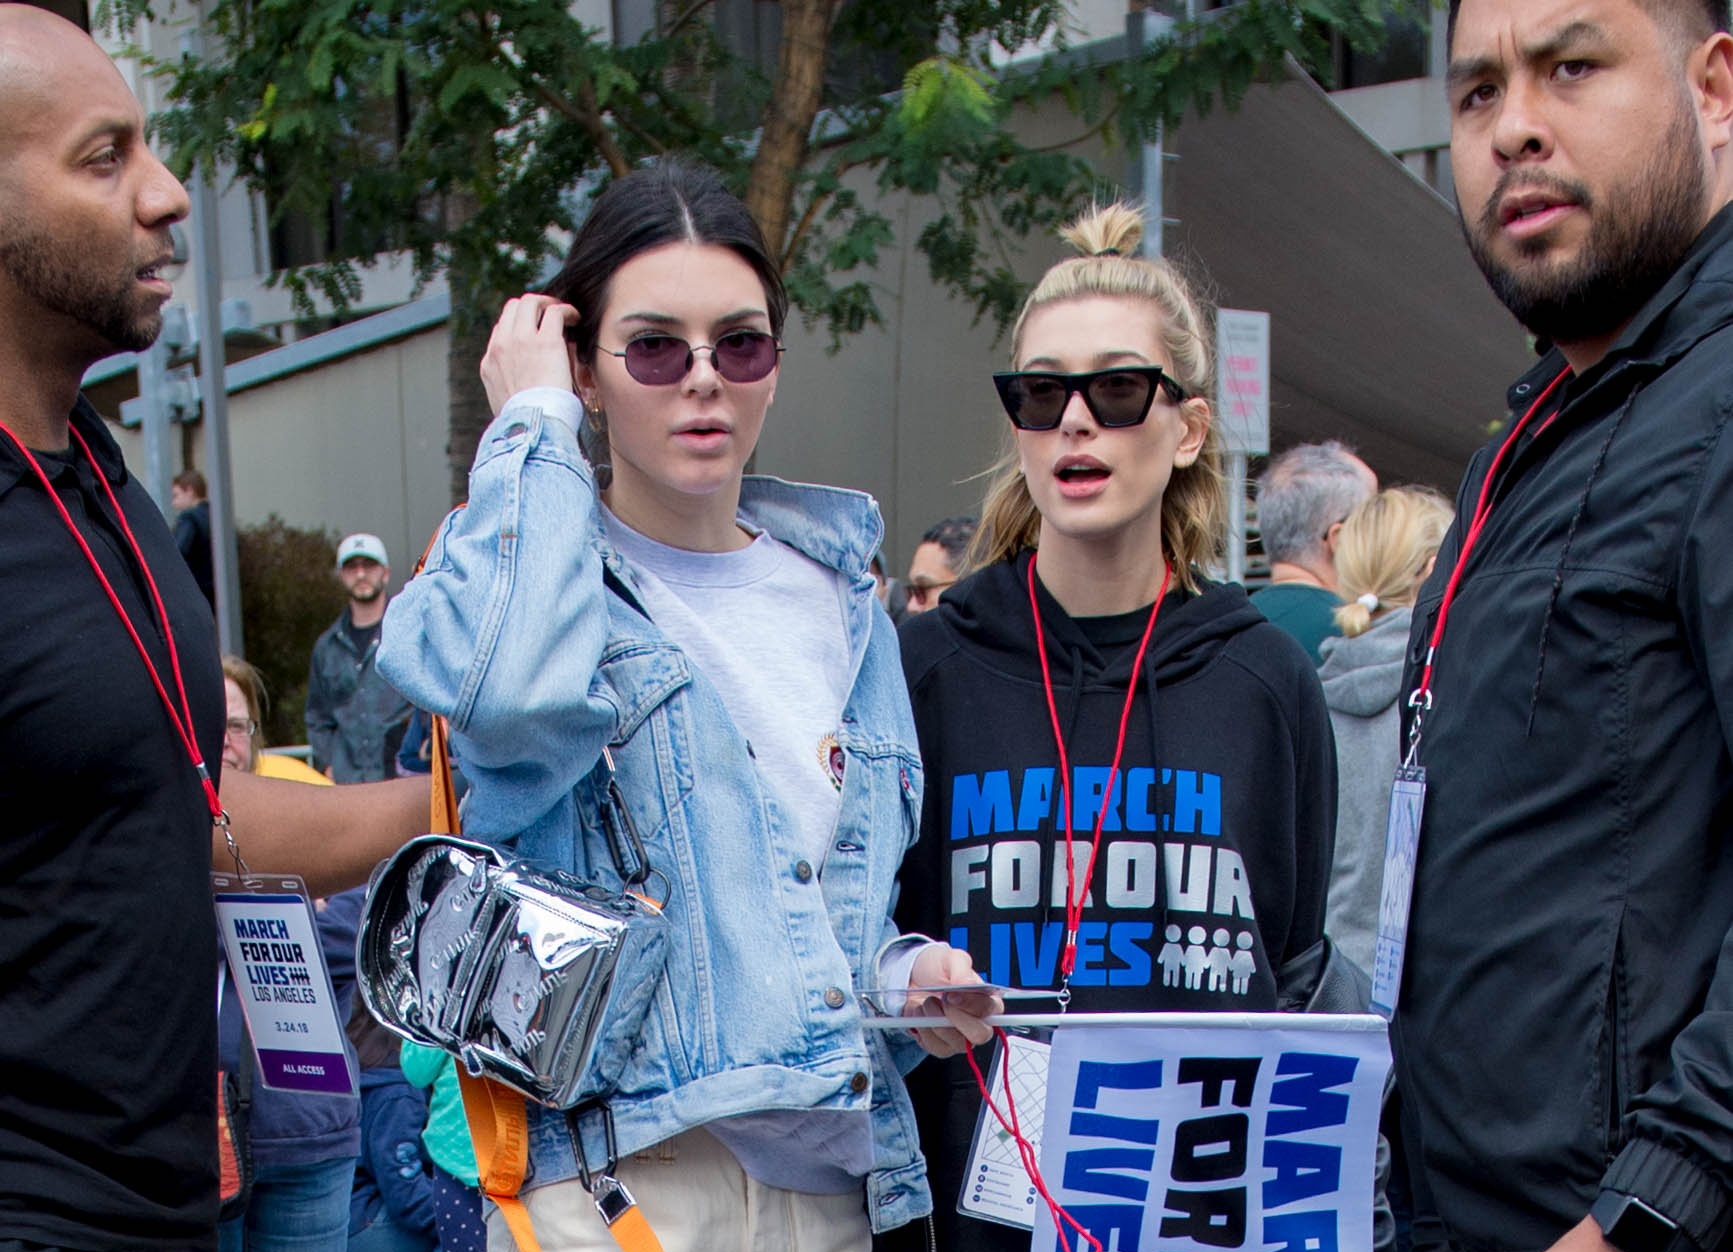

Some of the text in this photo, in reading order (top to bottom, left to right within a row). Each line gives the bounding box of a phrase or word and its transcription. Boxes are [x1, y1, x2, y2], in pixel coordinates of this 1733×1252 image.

[951, 766, 1221, 840] MARCH
[234, 919, 290, 939] MARCH
[247, 965, 289, 985] LIVES
[252, 987, 316, 1003] LOS ANGELES
[275, 1022, 309, 1033] 3.24.18
[283, 1064, 325, 1075] ALL ACCESS
